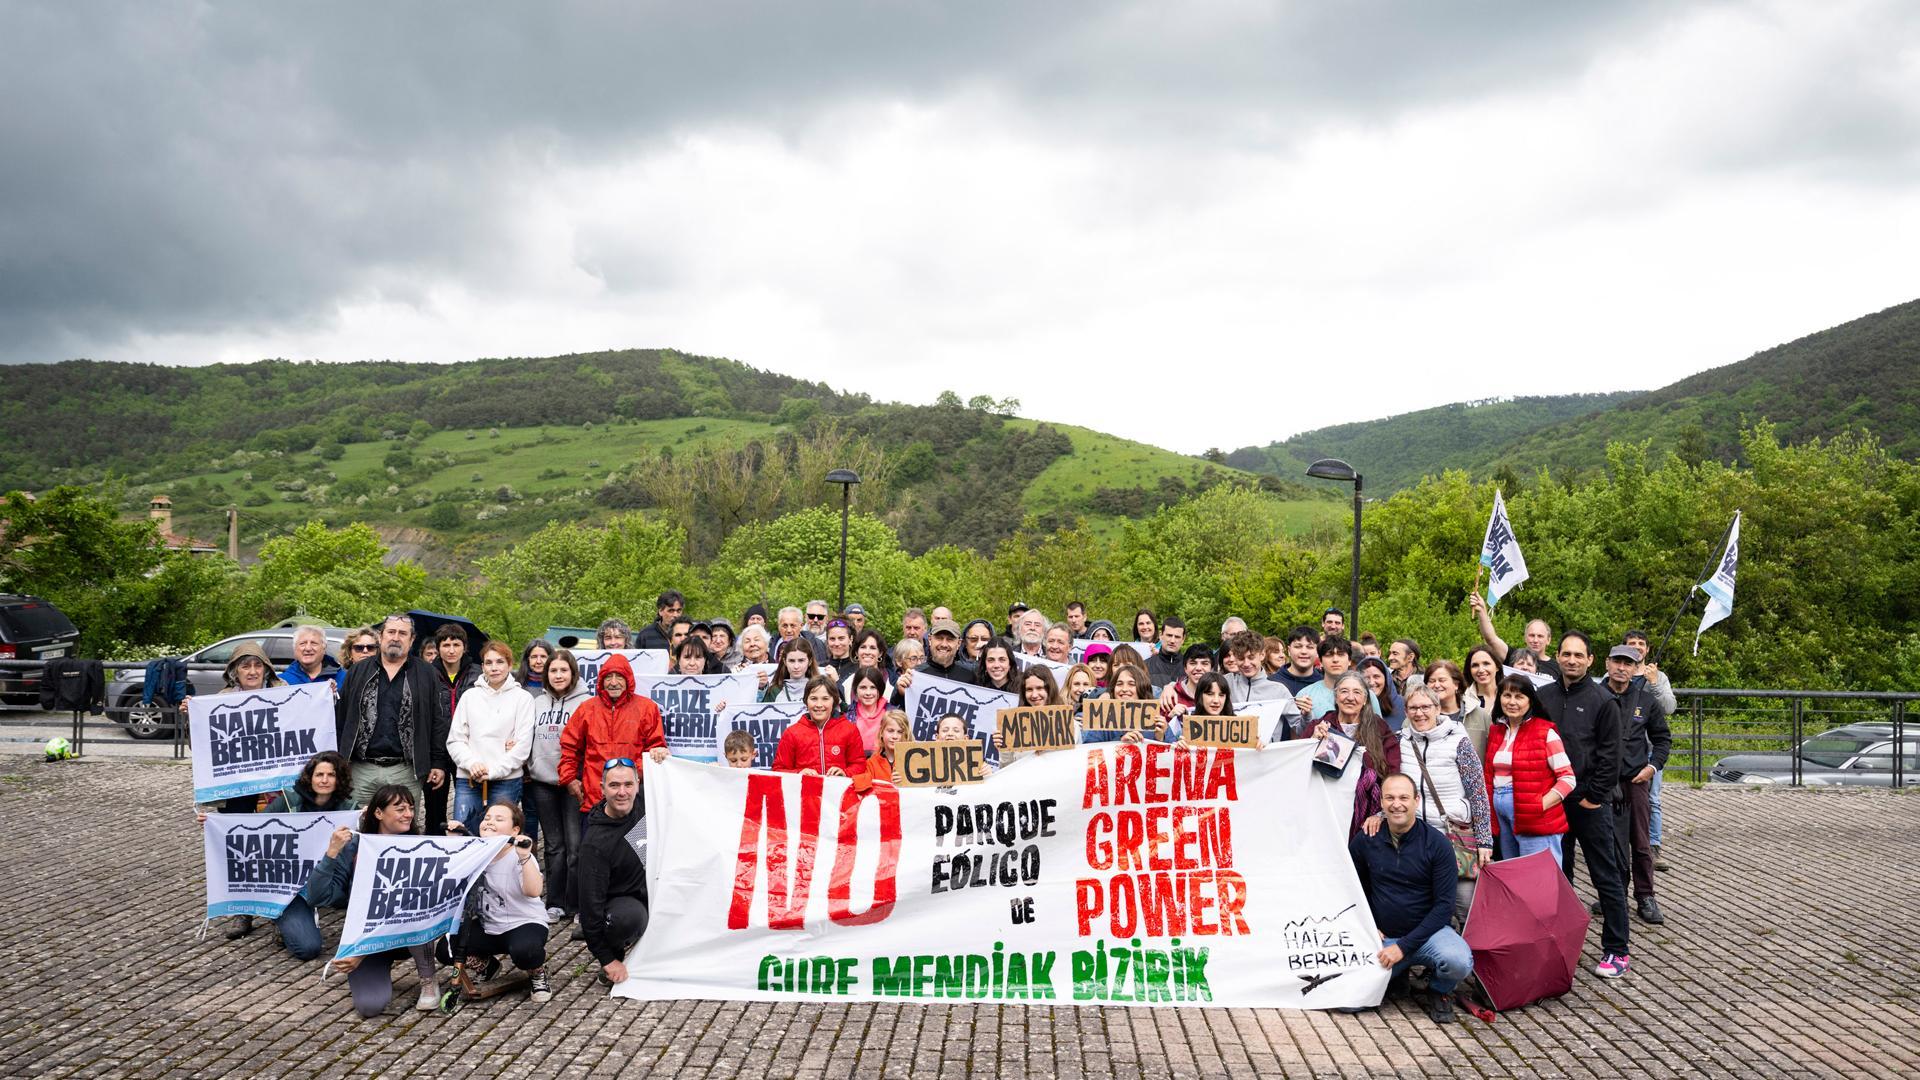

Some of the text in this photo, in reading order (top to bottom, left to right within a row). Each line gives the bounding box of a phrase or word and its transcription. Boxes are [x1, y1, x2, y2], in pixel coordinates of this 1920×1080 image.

[538, 711, 570, 726] ONDO
[651, 690, 710, 713] HAIZE
[915, 694, 980, 730] HAIZE
[209, 707, 280, 741] HAIZE
[662, 713, 718, 738] ERRIA
[1190, 719, 1250, 744] DITUGU
[211, 728, 318, 767] BERRIAK
[904, 746, 984, 783] GURE
[1082, 743, 1239, 810] ARENA
[934, 798, 1057, 848] PARQUE
[1085, 806, 1233, 871] GREEN
[226, 834, 299, 860] HAIZE
[728, 774, 902, 930] NO
[227, 859, 321, 886] BERRIA
[373, 857, 451, 888] HAIZE
[1010, 896, 1035, 925] DE
[1075, 869, 1251, 939] POWER
